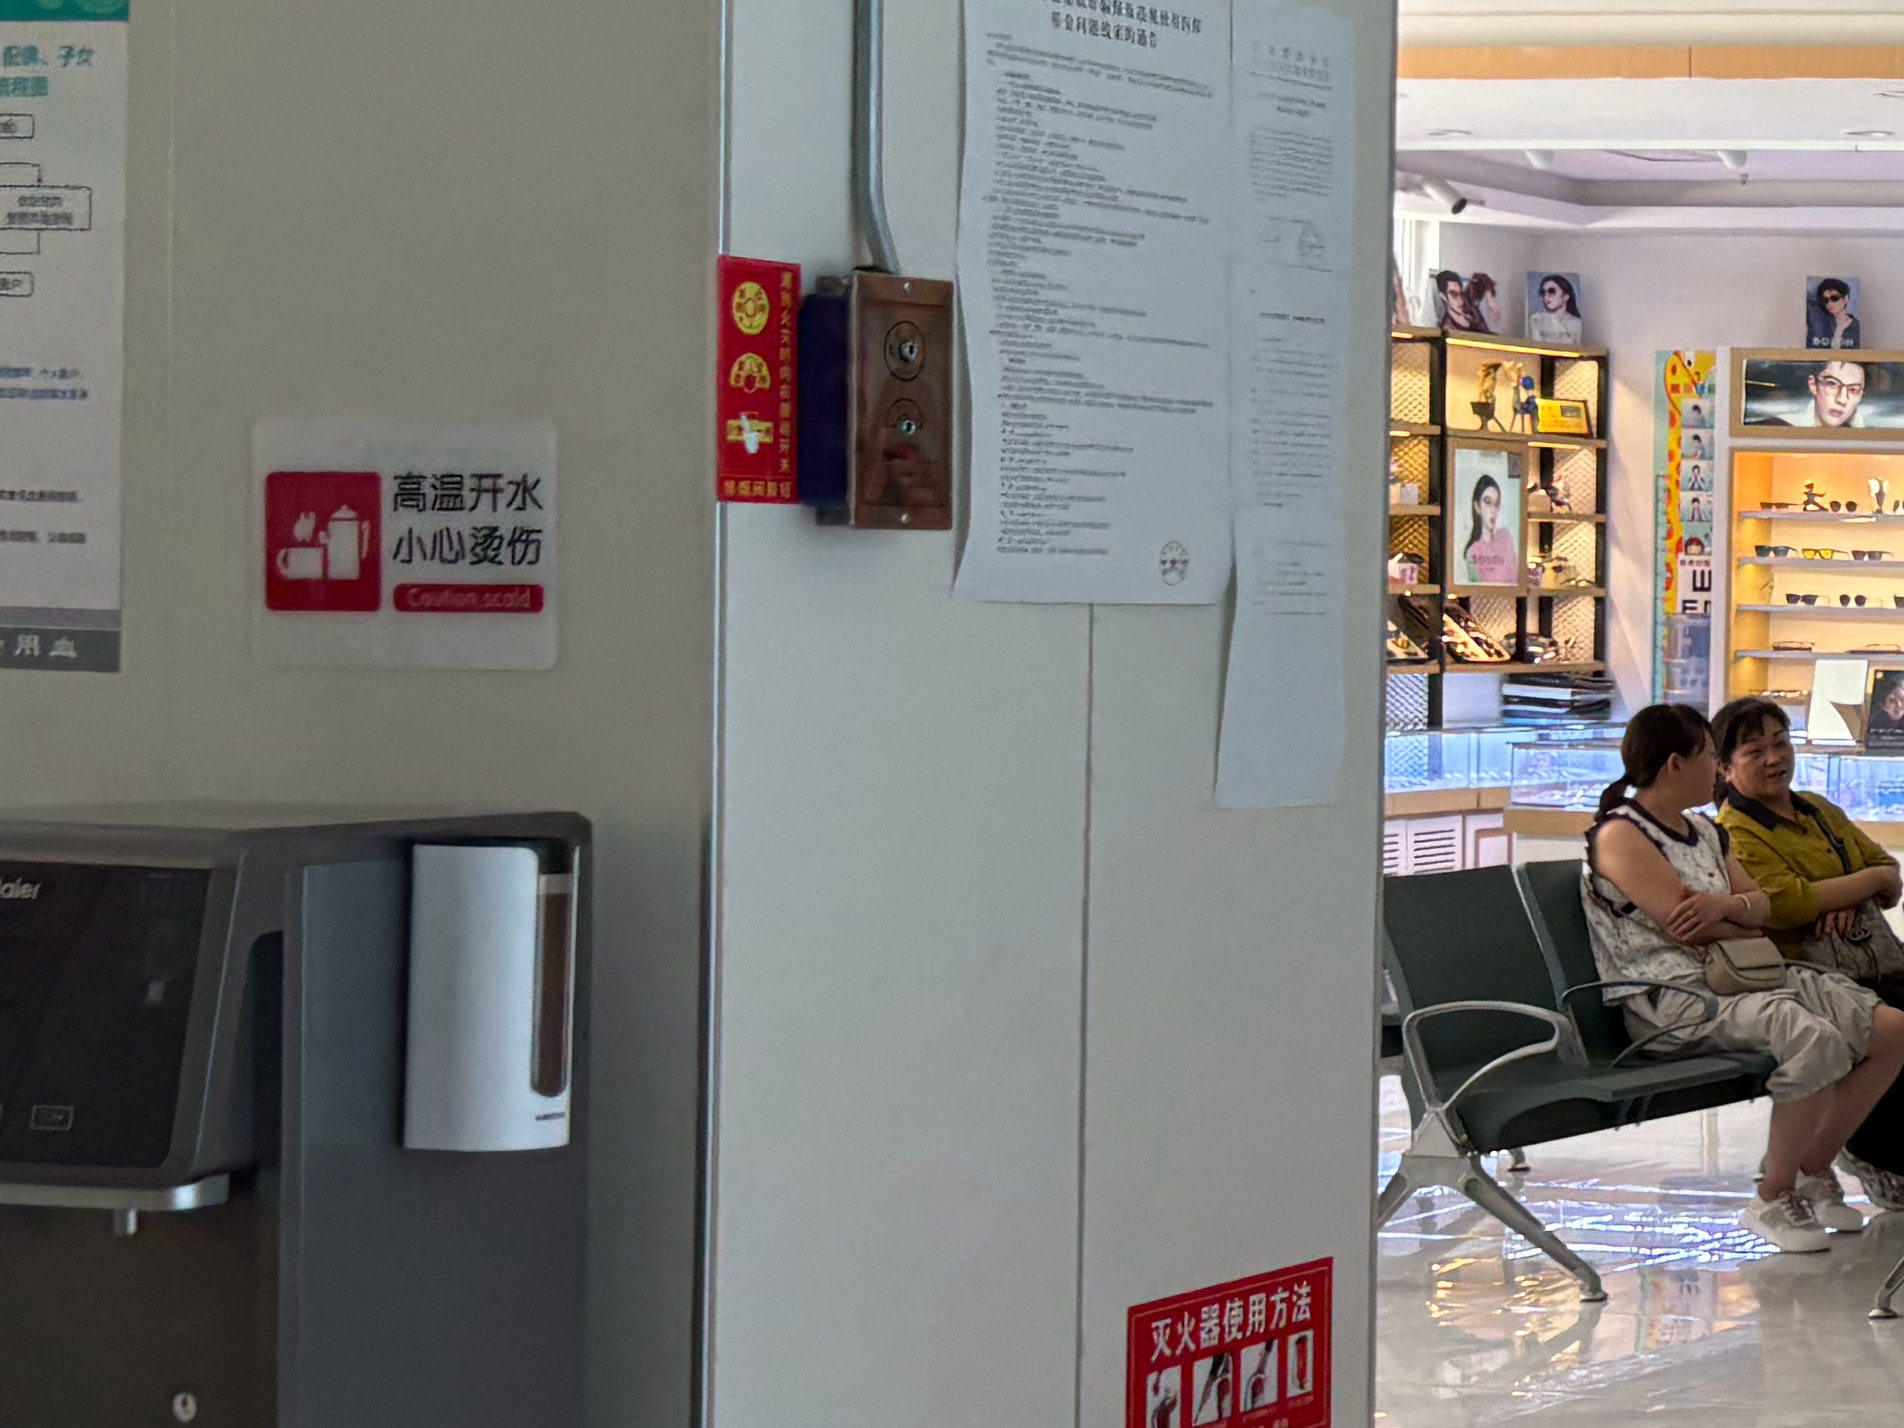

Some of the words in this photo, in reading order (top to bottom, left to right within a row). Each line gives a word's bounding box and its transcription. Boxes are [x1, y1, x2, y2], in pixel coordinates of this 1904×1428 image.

[392, 472, 544, 513] 高温开水
[392, 526, 543, 566] 小心烫伤
[407, 586, 478, 607] Caution
[480, 586, 532, 608] scald
[1151, 1279, 1312, 1364] 灭火器使用方法
